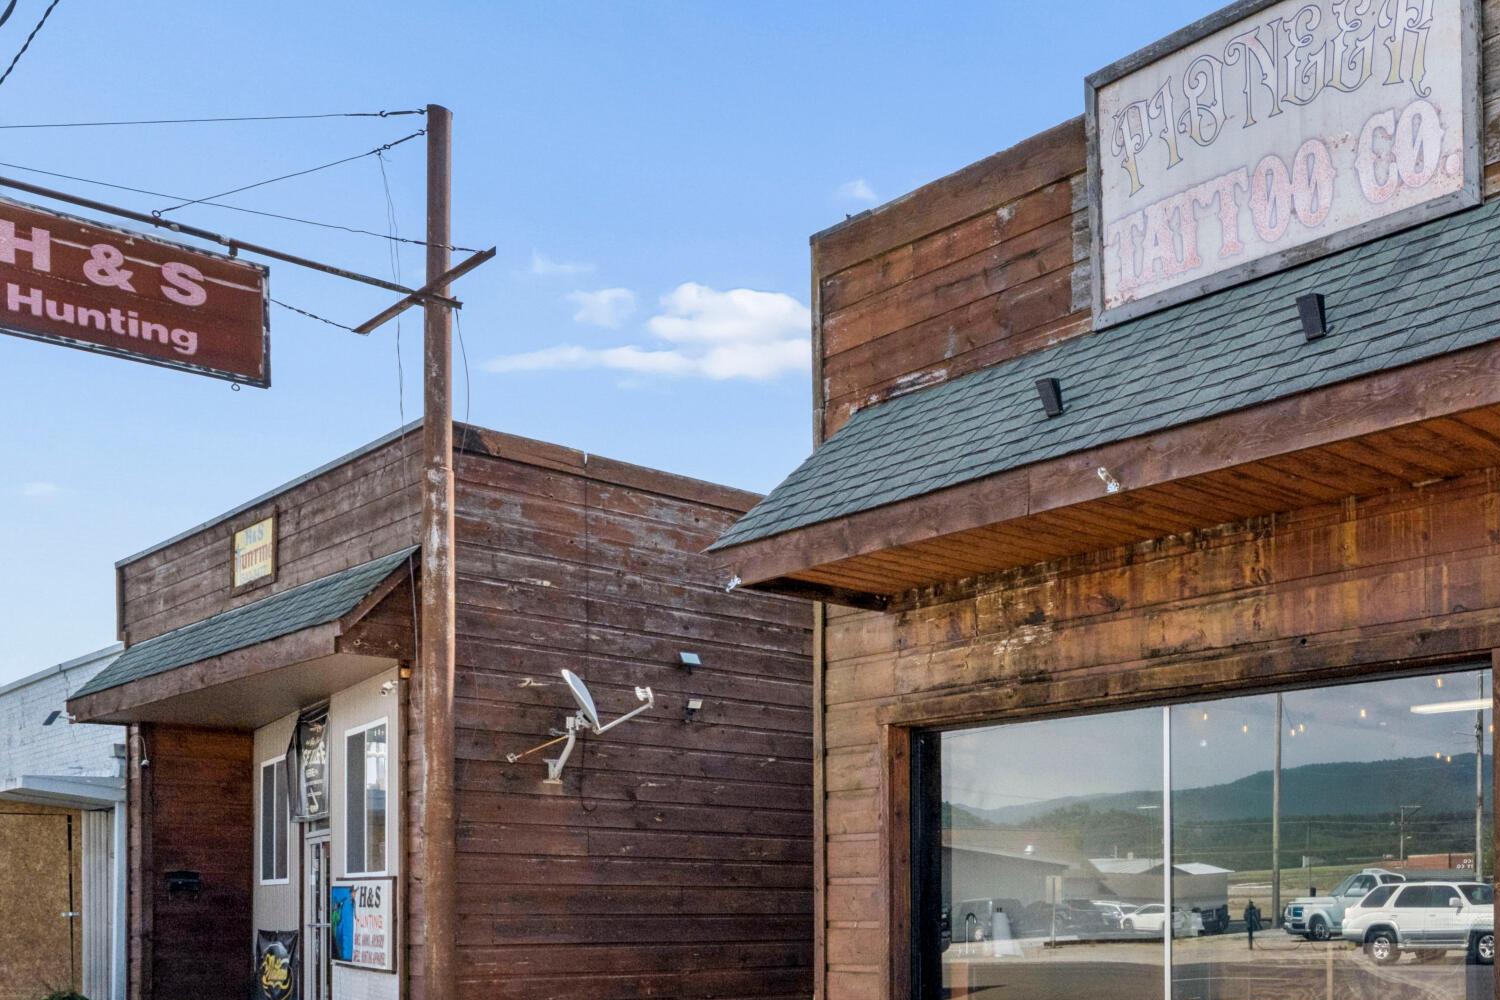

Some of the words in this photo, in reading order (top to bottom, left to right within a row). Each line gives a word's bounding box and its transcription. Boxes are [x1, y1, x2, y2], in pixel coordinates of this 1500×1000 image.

[1111, 0, 1433, 197] PIONEER
[1107, 139, 1337, 290] TATTOO
[1354, 100, 1460, 204] CO.
[0, 218, 51, 273] H
[83, 243, 137, 294] &
[160, 262, 207, 306] S
[7, 283, 198, 356] Hunting
[359, 886, 382, 908] H&S
